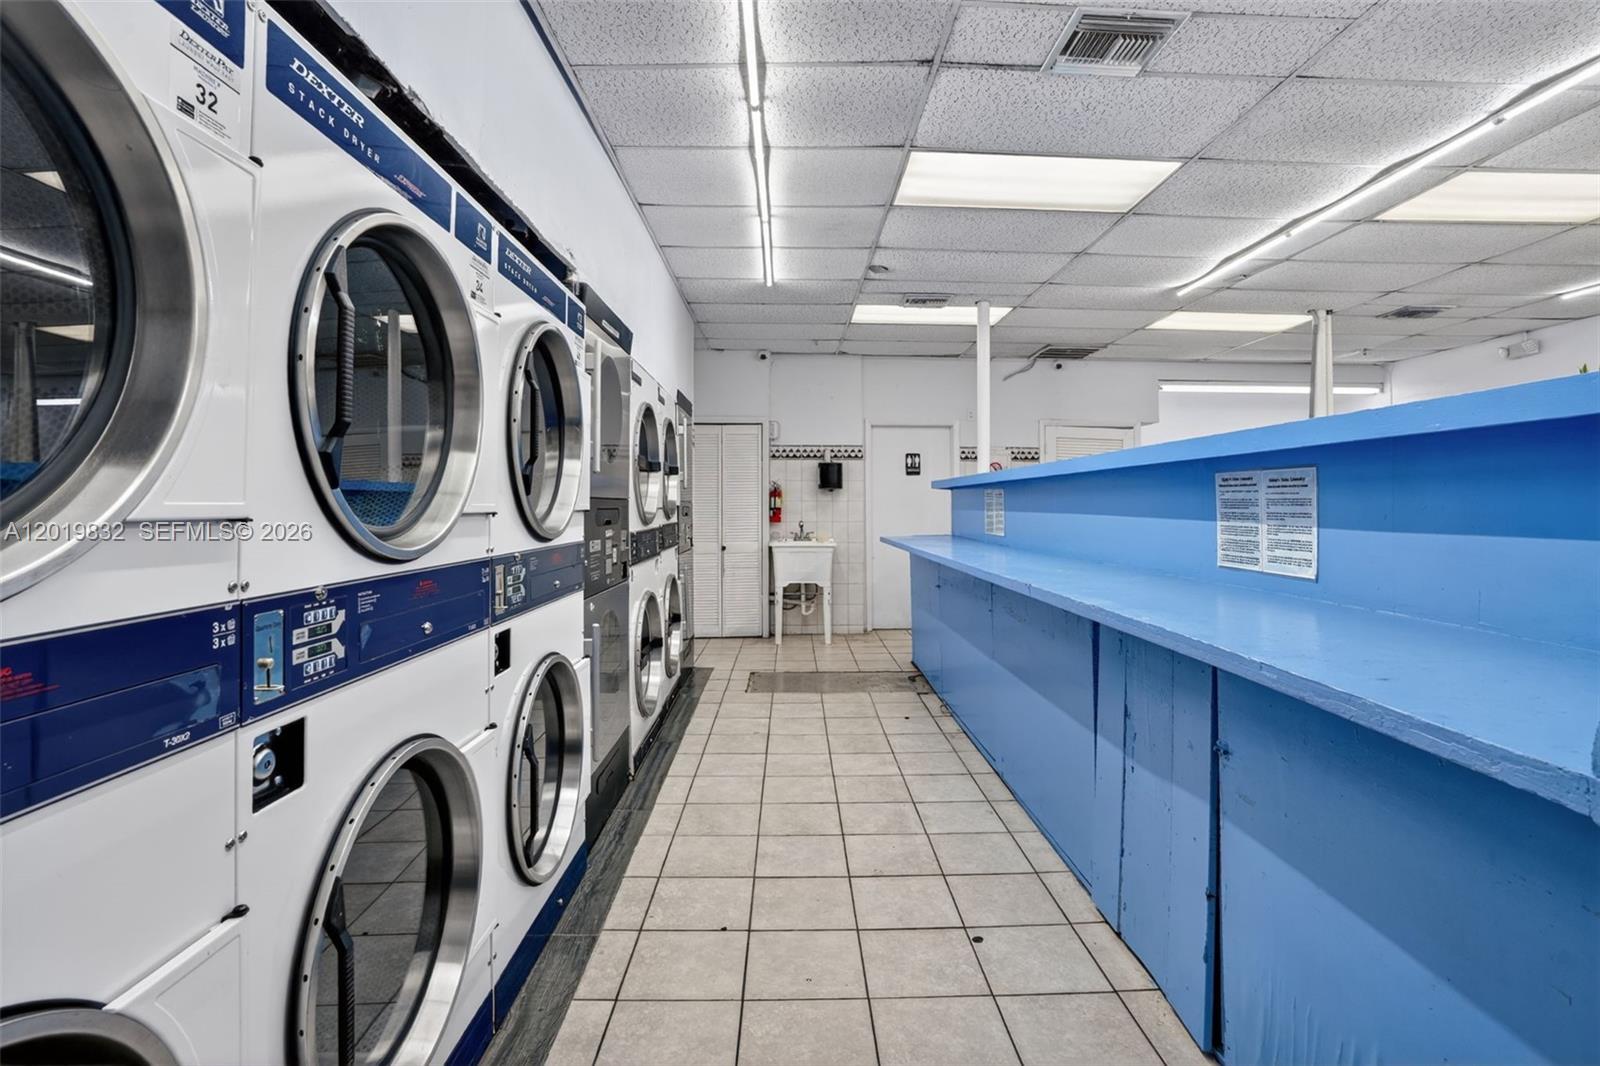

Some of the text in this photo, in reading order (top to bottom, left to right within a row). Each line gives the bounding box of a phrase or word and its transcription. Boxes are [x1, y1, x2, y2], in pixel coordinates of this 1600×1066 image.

[196, 83, 217, 115] 32
[289, 57, 365, 129] DEXTER
[288, 82, 380, 164] STACK DRYER
[505, 247, 532, 275] DEXTER
